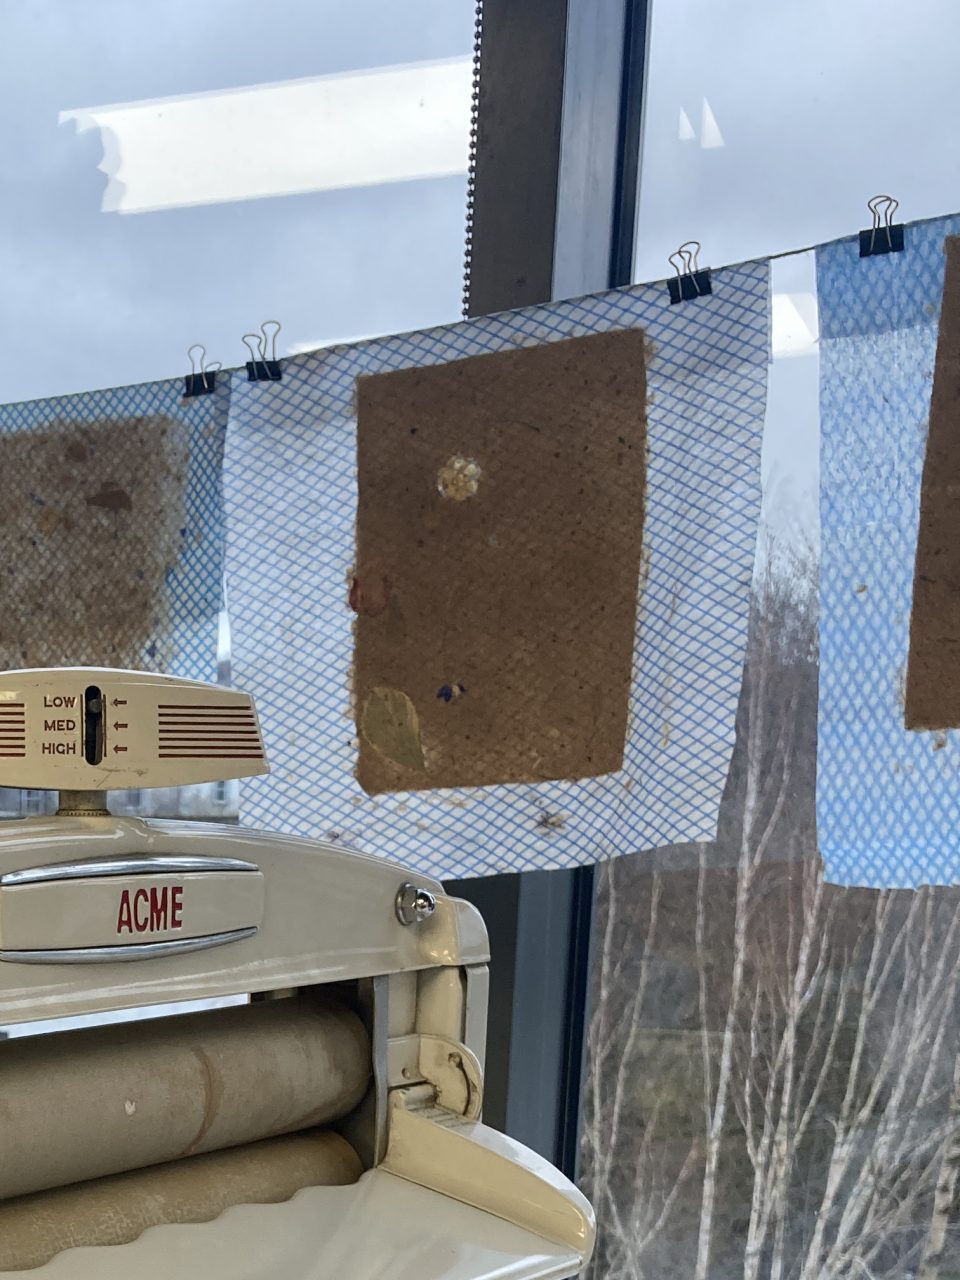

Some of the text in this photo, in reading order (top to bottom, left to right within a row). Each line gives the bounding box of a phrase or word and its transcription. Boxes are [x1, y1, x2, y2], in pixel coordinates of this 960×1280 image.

[43, 695, 76, 709] LOW
[44, 719, 76, 732] MED
[42, 742, 76, 755] HIGH
[116, 886, 183, 934] ACME
